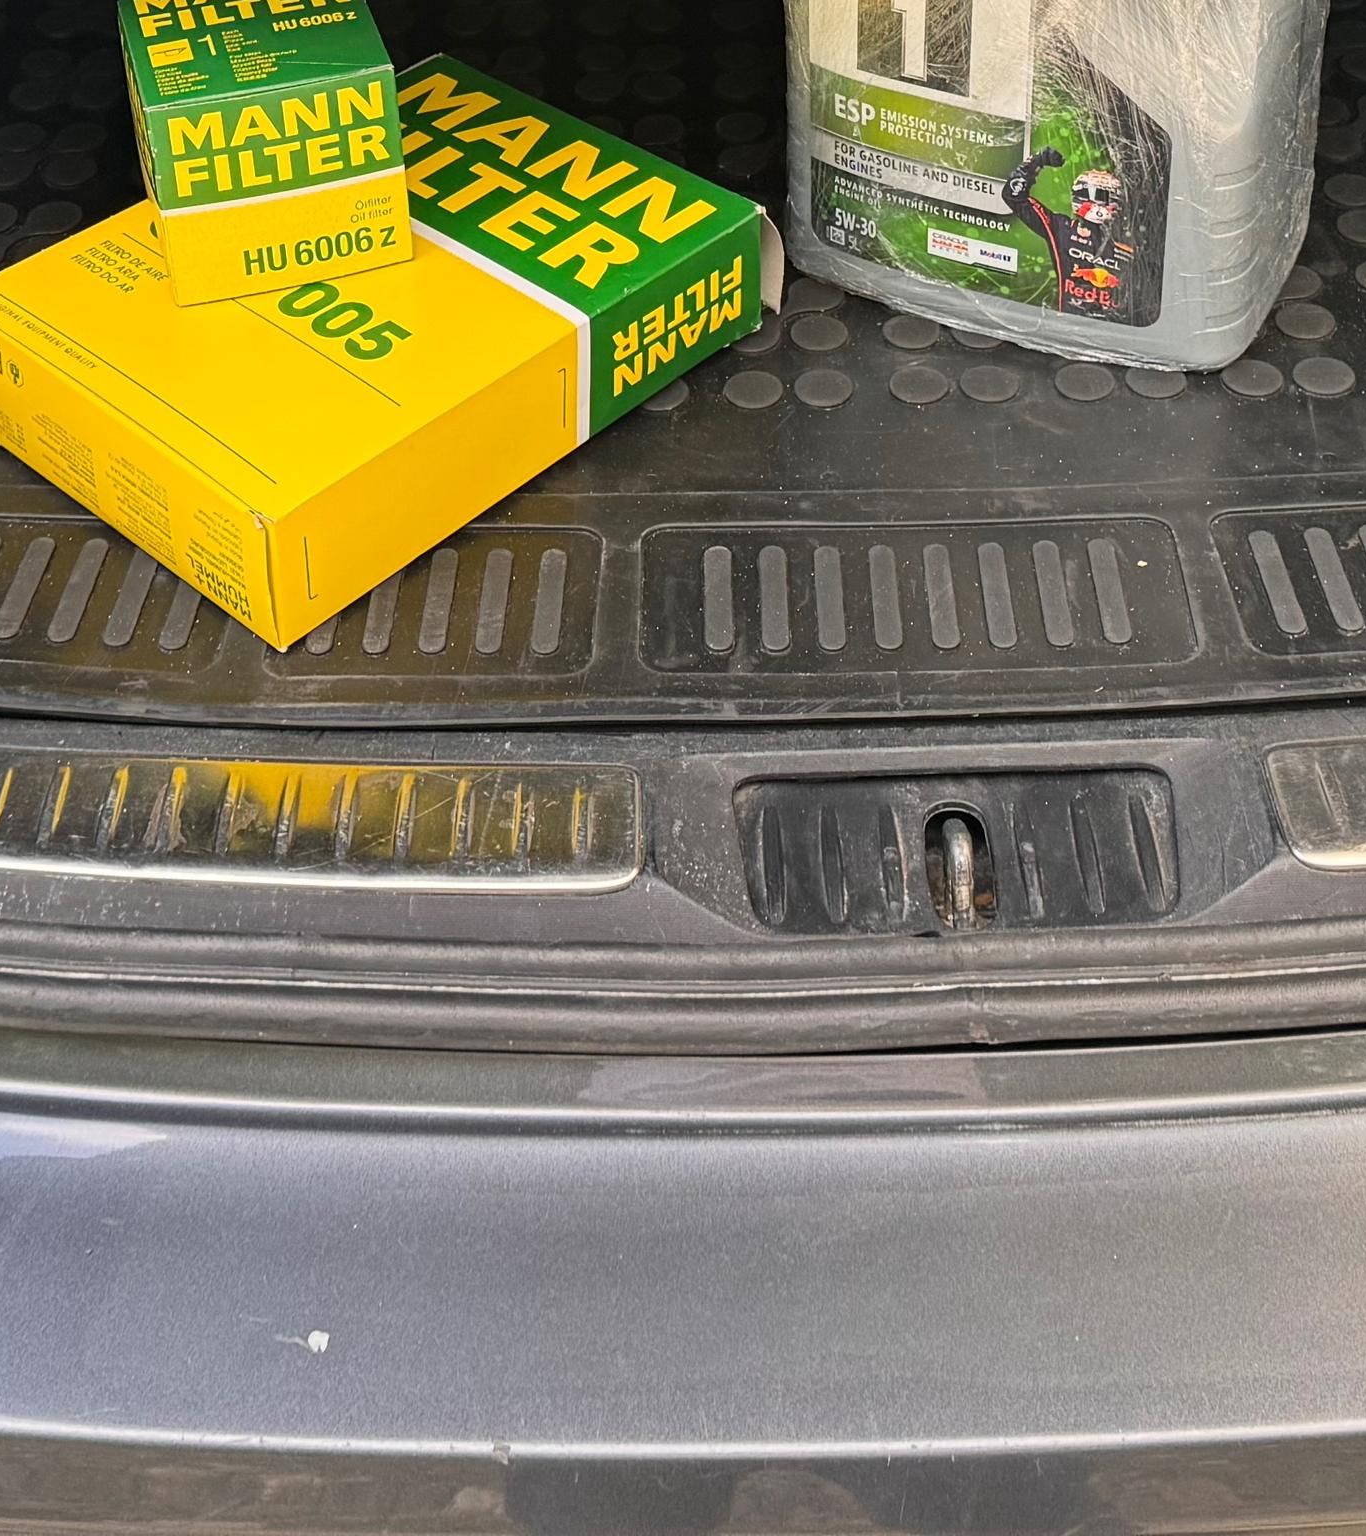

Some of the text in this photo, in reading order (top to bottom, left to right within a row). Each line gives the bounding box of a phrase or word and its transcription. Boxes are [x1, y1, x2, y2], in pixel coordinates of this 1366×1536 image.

[198, 34, 217, 56] 1
[273, 19, 298, 32] HU
[300, 11, 343, 29] 6006
[167, 81, 385, 156] MANN
[835, 93, 995, 146] ESP EMISSION SYSTEMS
[880, 119, 954, 150] PROTECTION
[173, 126, 390, 198] FILTER
[397, 72, 717, 244] MANN
[834, 154, 883, 180] ENGINES
[834, 140, 996, 196] FOR GASOLINE AND DIESEL
[350, 212, 366, 224] Oil
[401, 123, 640, 290] ILTER
[834, 184, 864, 203] ENGINE
[834, 175, 1011, 233] ADVANCED SYNTHETIC TECHNOLOGY
[835, 207, 876, 239] 5W-30
[70, 254, 134, 294] FILTRO DO AR
[85, 247, 140, 282] FILTRO ARIA
[99, 239, 169, 282] FILTRO DE AIRE
[243, 225, 397, 276] HU 6006 z
[612, 255, 742, 361] FILTER
[1065, 279, 1097, 302] Red
[21, 320, 66, 350] EQUIPMENT
[63, 347, 97, 369] QUALITY
[278, 281, 413, 360] 005
[613, 288, 742, 397] MANN
[185, 552, 249, 608] HUMMEL
